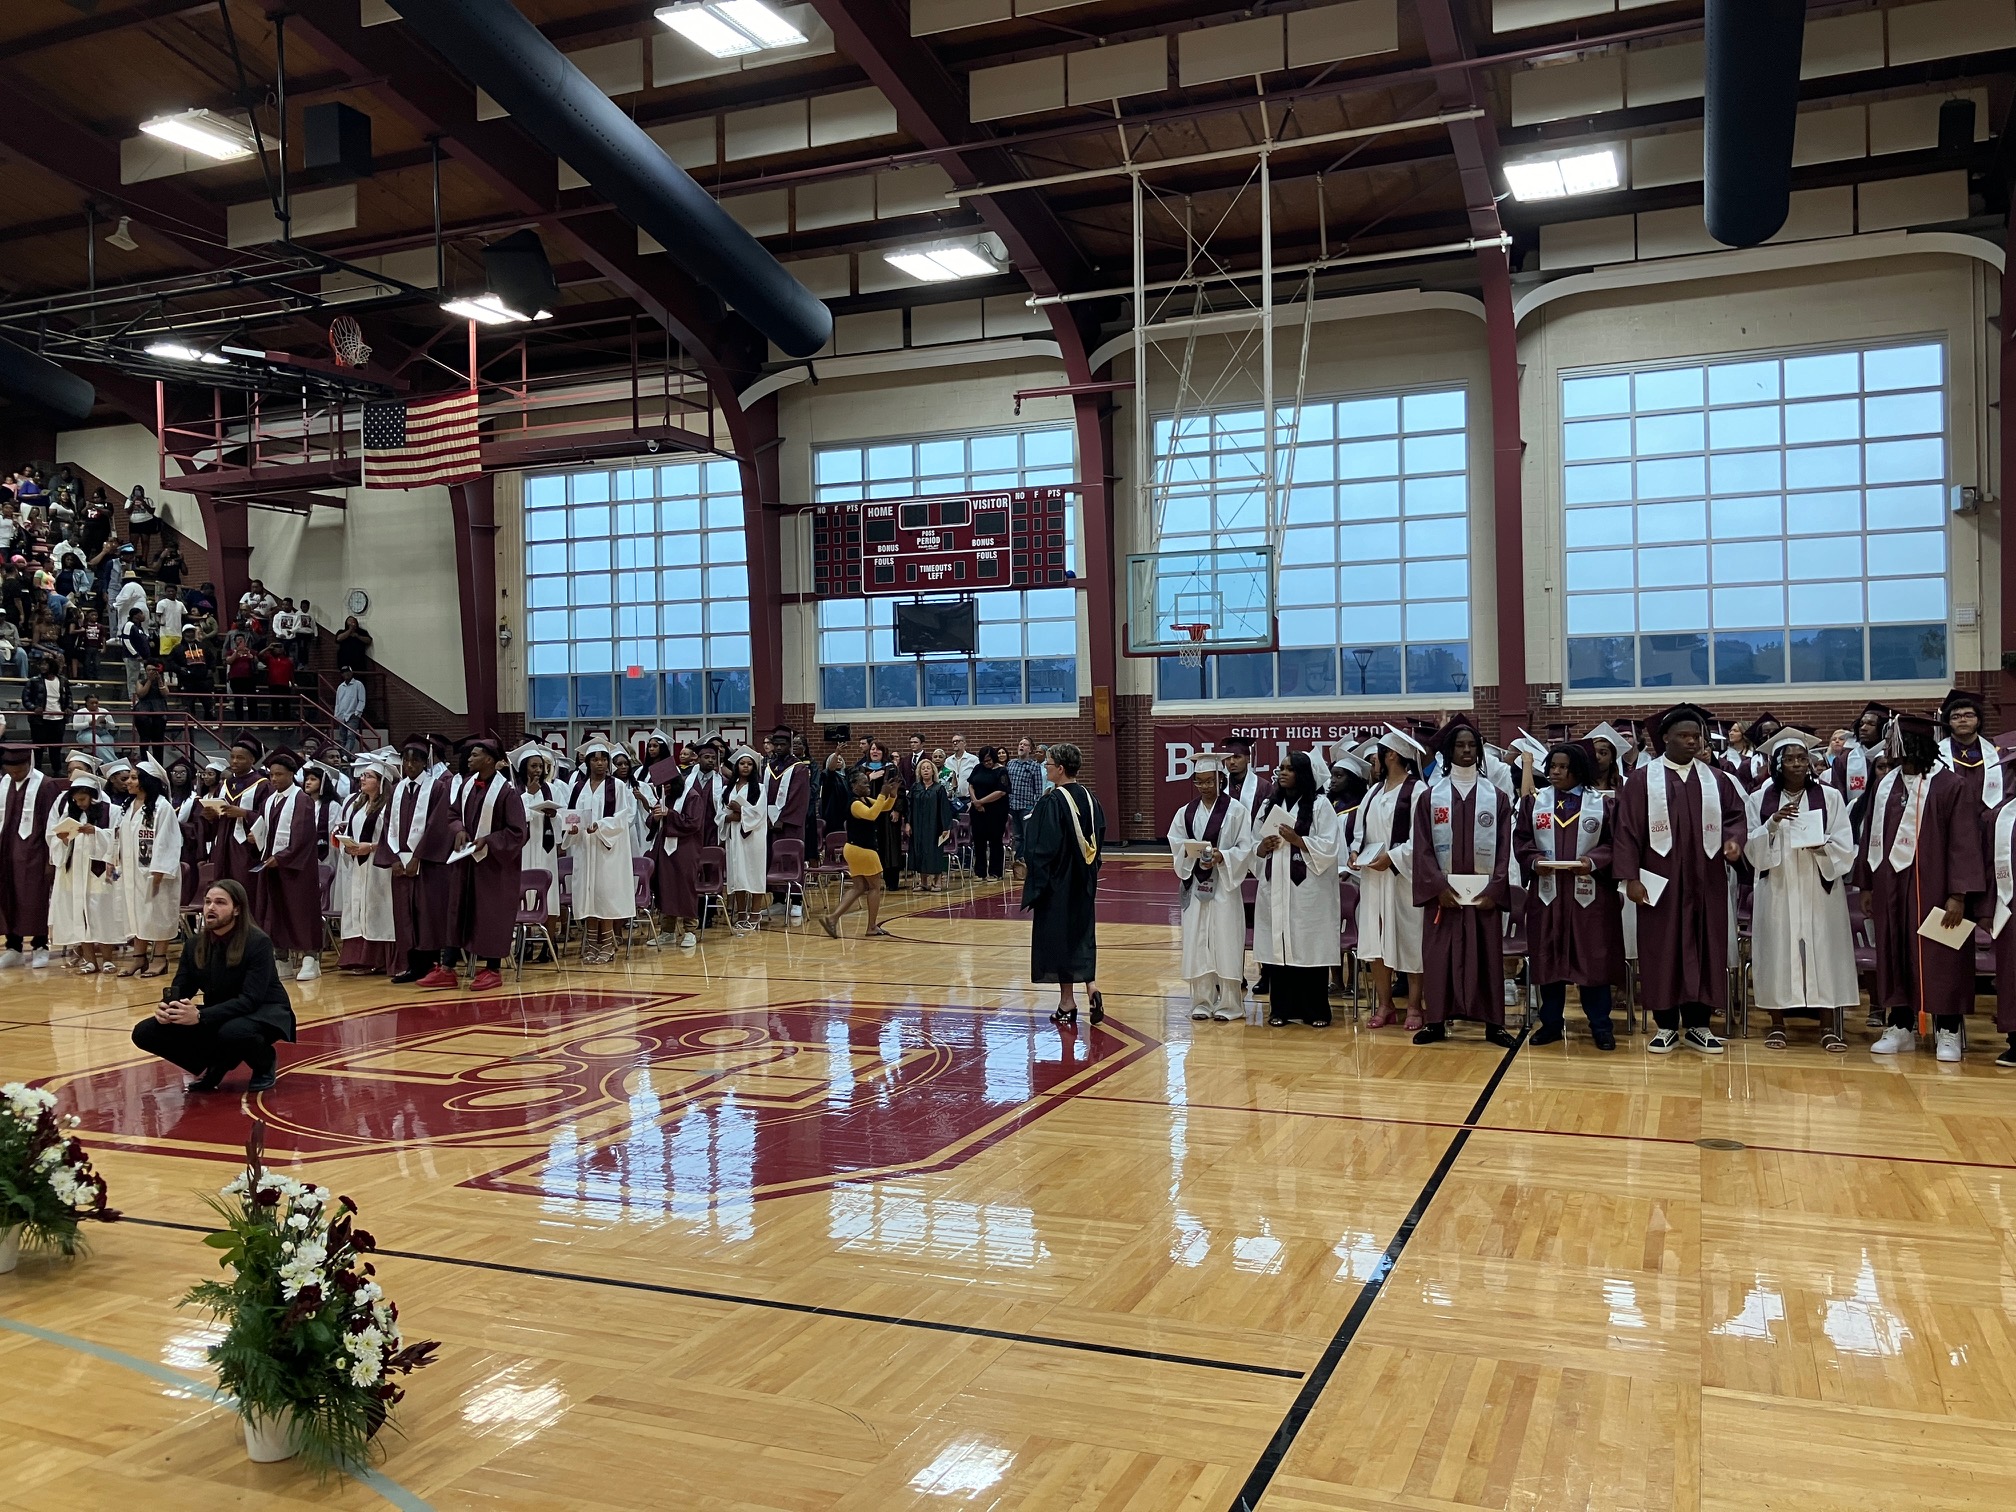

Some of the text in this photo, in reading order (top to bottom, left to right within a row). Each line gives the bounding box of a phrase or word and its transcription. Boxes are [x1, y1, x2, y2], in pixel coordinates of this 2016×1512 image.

[1034, 490, 1039, 499] F
[1047, 488, 1061, 498] PTS
[972, 498, 1008, 510] VISITOR
[817, 506, 827, 514] NO
[868, 506, 893, 517] HOME
[916, 536, 941, 545] PERIOD
[971, 538, 995, 547] BONUS
[877, 544, 900, 552] BONUS
[976, 551, 998, 559] FOULS
[874, 558, 894, 566] FOULS
[919, 563, 952, 573] TIMEOUTS
[928, 572, 944, 580] LEFT
[1231, 727, 1280, 739] SCOTT
[1286, 726, 1322, 739] HIGH
[1651, 824, 1669, 833] 2024
[138, 829, 154, 838] SHS
[1996, 870, 2010, 879] 2024
